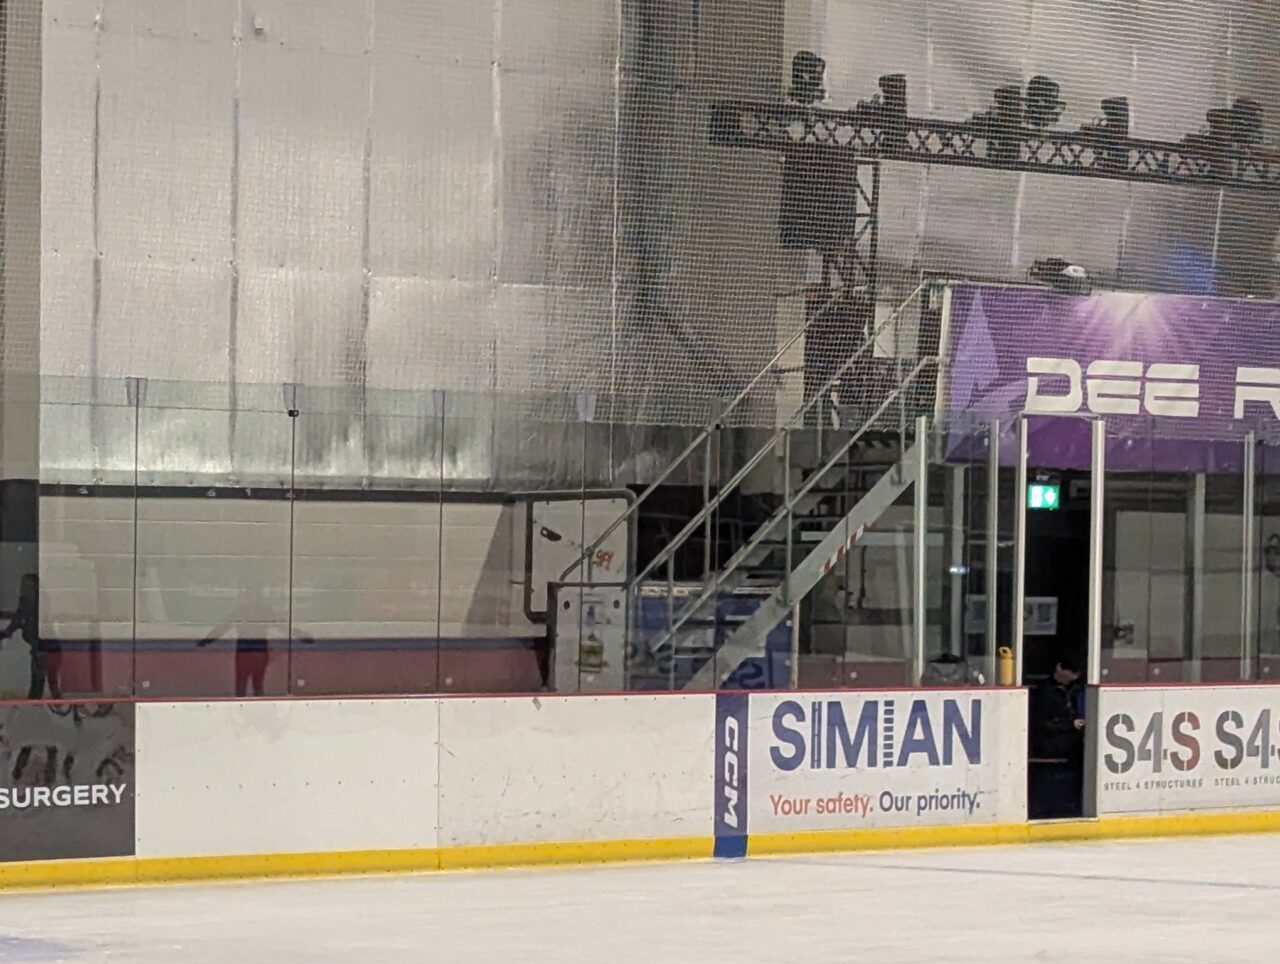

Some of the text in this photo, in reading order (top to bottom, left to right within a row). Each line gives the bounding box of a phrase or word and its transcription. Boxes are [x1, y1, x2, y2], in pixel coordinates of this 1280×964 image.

[1024, 357, 1199, 417] DEE
[769, 699, 982, 772] SIMIAN
[1104, 711, 1201, 774] S4S
[1214, 708, 1280, 770] S4
[724, 715, 740, 829] CCM
[1104, 782, 1132, 791] STEEL
[1144, 778, 1204, 790] STRUCTURES
[1214, 777, 1241, 787] STEEL
[770, 788, 981, 818] Your safety. Our priority.
